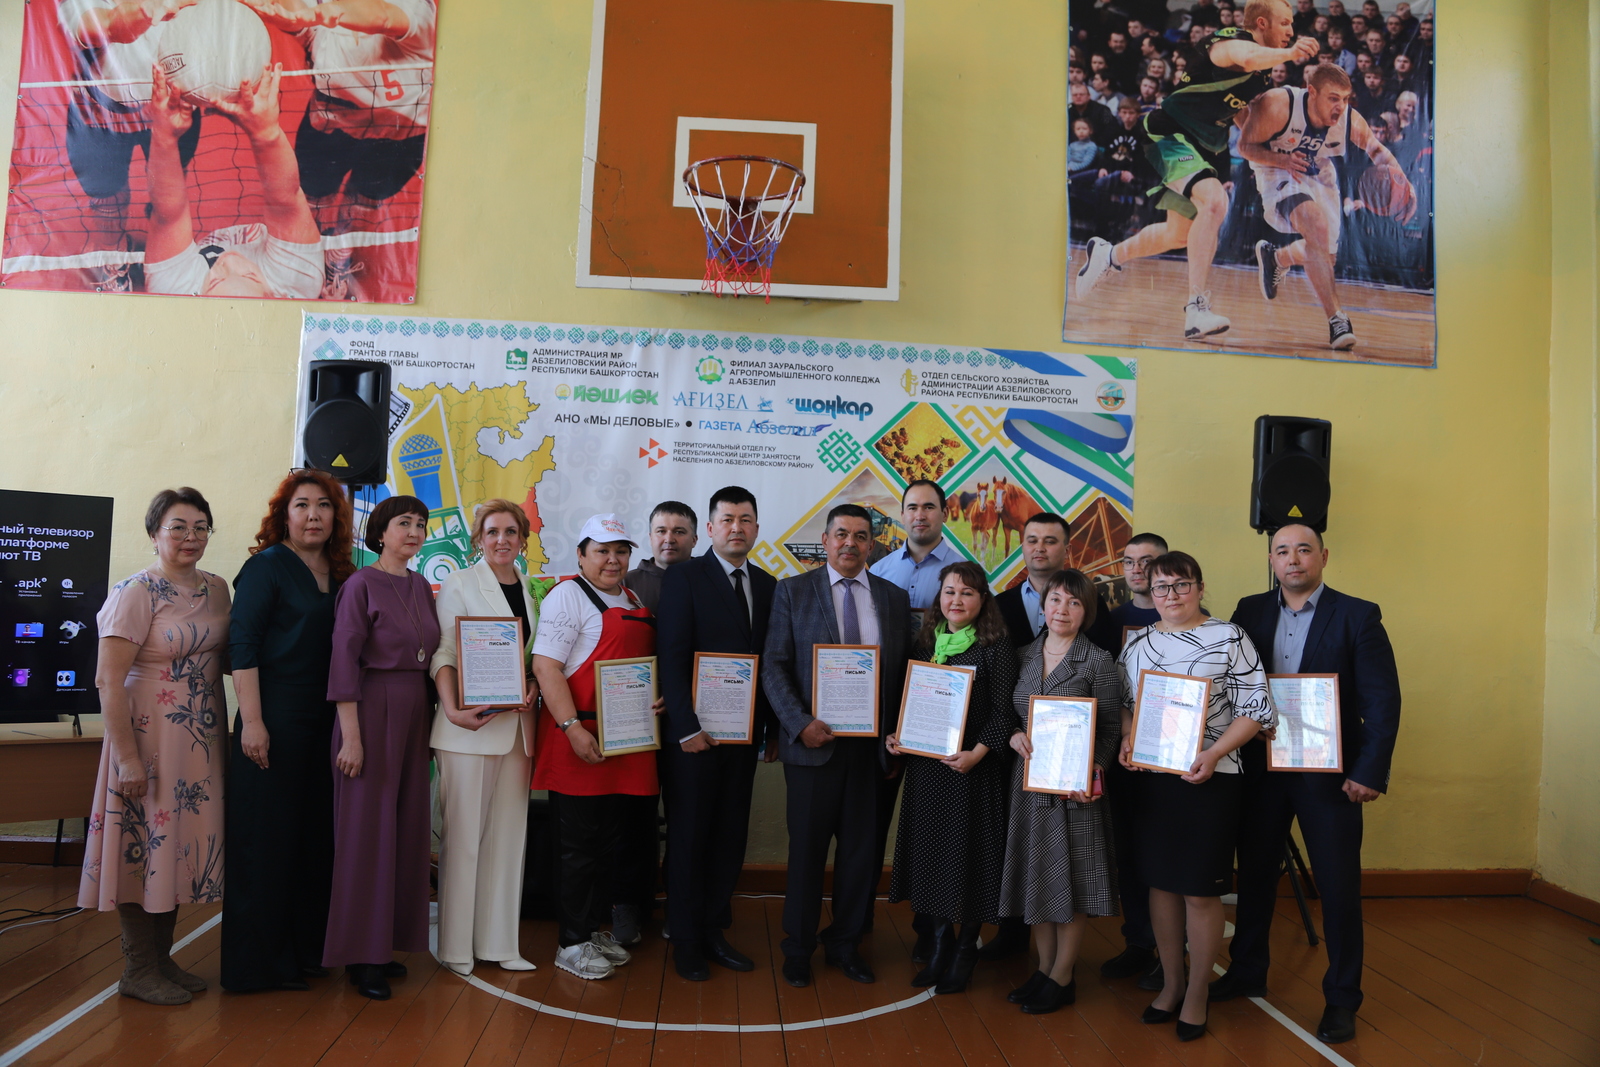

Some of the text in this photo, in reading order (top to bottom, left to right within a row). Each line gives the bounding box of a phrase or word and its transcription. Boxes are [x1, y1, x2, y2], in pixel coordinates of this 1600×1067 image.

[1299, 136, 1324, 152] 25
[350, 340, 374, 348] ФОНД
[349, 349, 386, 357] ГРАНТОВ
[532, 348, 608, 358] АДМИНИСТРАЦИЯ
[406, 360, 475, 370] БАШКОРТОСТАН
[532, 358, 637, 369] АБЗЕЛИЛОВСКИЙ РАЙОН
[730, 360, 834, 372] ФИЛИАЛ ЗАУРАЛЬСКОГО
[532, 366, 659, 378] РЕСПУБЛИКИ БАШКОРТОСТАН
[730, 369, 880, 384] АГРОПРОМЫШЛЕННОГО КОЛЛЕДЖА
[729, 378, 776, 386] Д.АБЗЕЛИЛ
[922, 372, 1049, 386] ОТДЕЛ СЕЛЬСКОГО ХОЗЯЙСТВА
[921, 380, 1071, 396] АДМИНИСТРАЦИИ АБЗЕЛИЛОВСКОГО
[921, 388, 1078, 405] РАЙОНА РЕСПУБЛИКИ БАШКОРТОСТАН
[554, 414, 817, 436] АНО «МЫ ДЕЛОВЫЕ» ГАЗЕТА Абзелил
[674, 442, 740, 450] ТЕРРИТОРИАЛЬНЫЙ
[673, 449, 738, 458] РЕСПУБЛИКАНСКИЙ
[673, 456, 713, 464] НАСЕЛЕНИЯ
[725, 459, 786, 467] АБЗЕЛИЛОВСКОМУ
[27, 527, 94, 540] телевизор
[0, 537, 69, 550] платформе
[0, 551, 41, 561] ют ТВ
